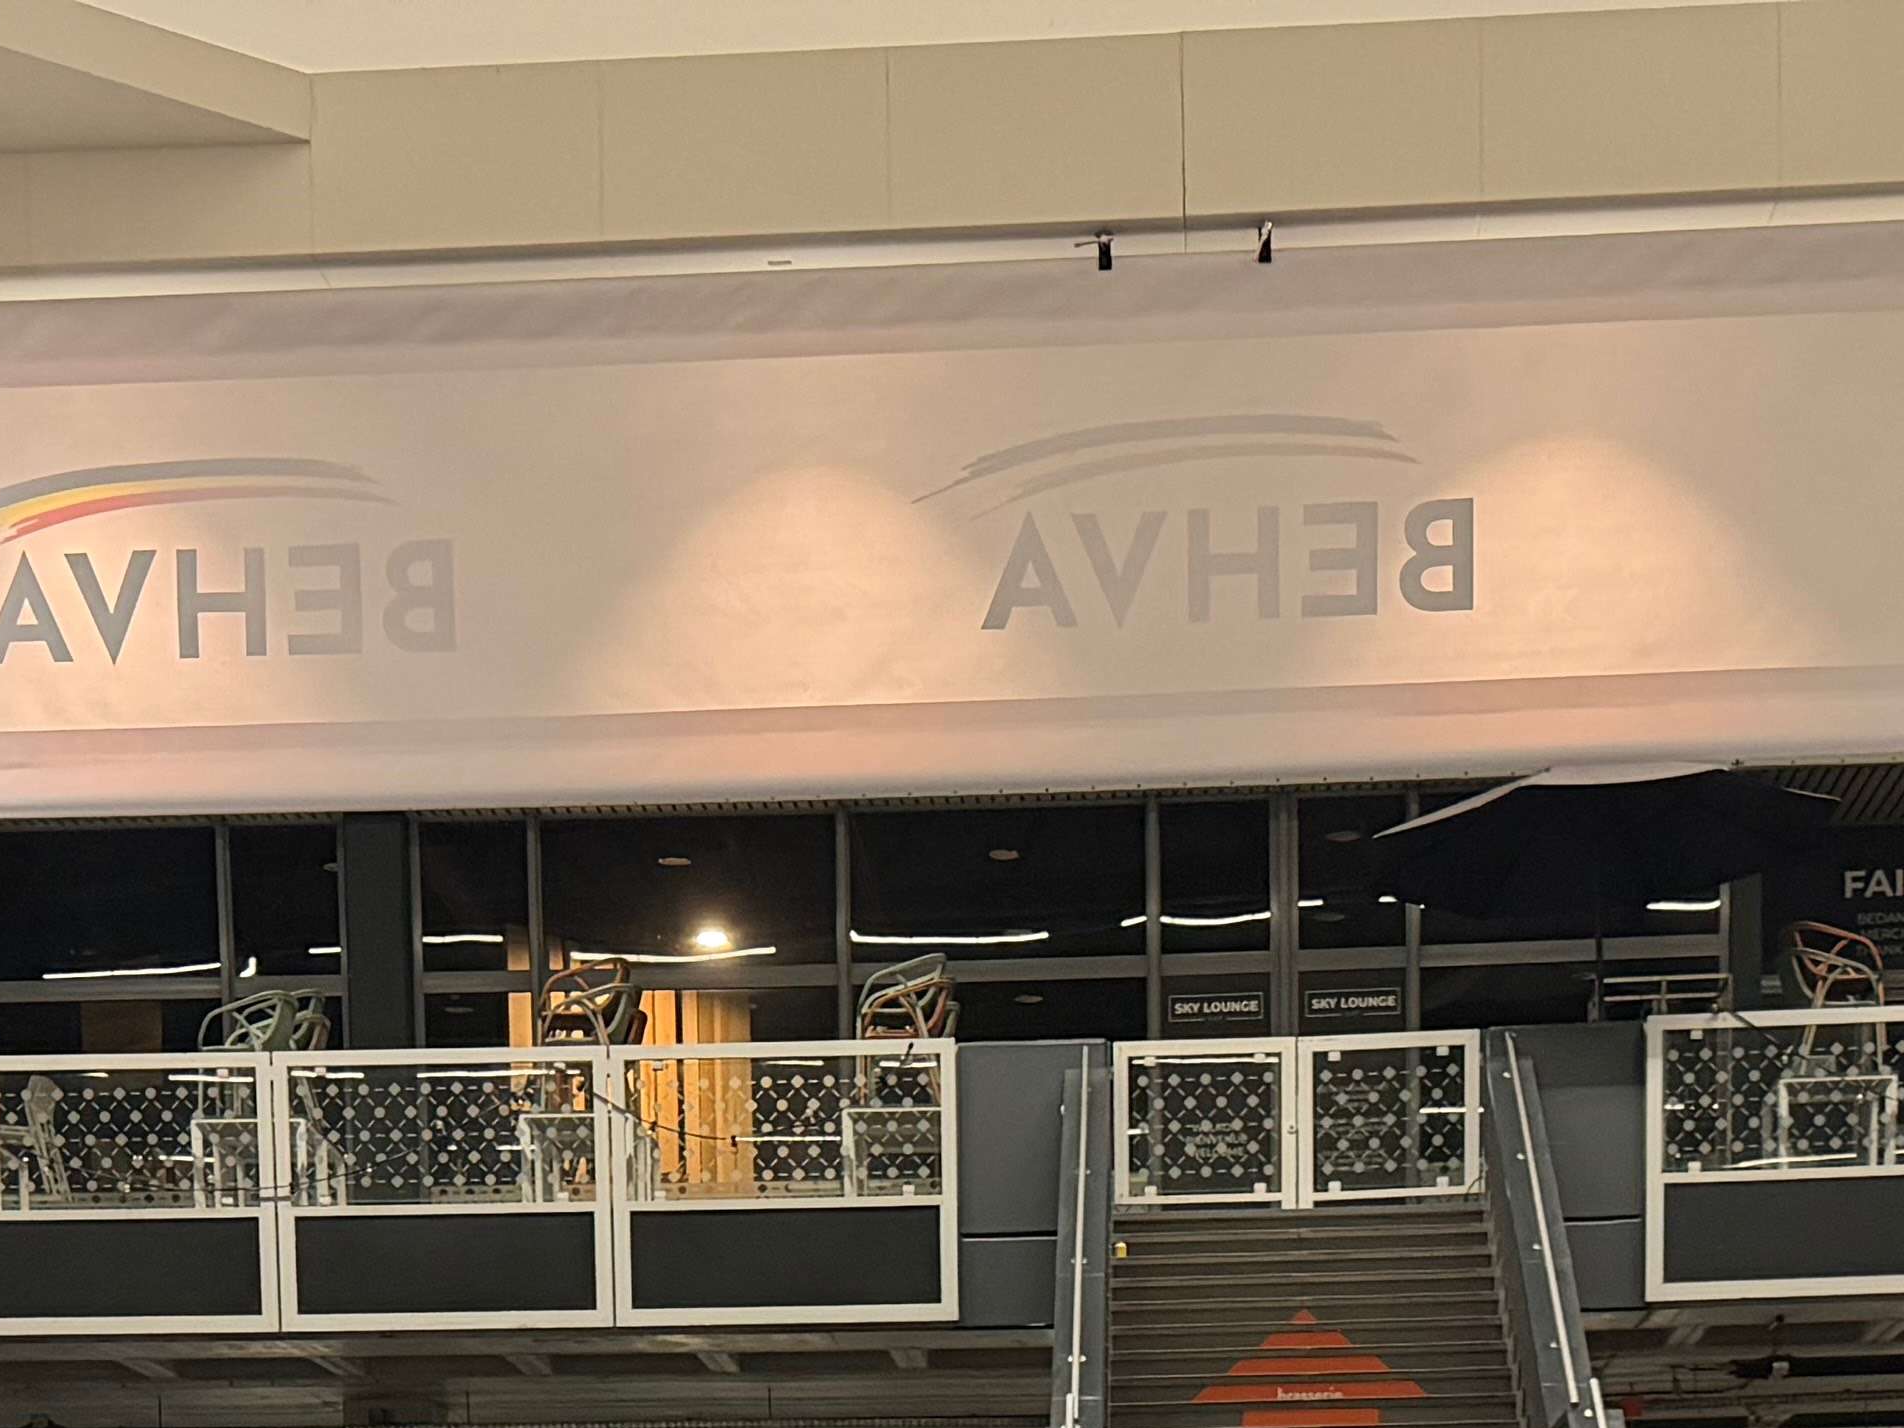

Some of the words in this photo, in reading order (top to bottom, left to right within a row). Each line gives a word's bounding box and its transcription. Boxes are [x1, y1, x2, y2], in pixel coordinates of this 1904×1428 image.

[1174, 1003, 1201, 1015] SKY
[1204, 1001, 1260, 1013] LOUNGE
[1311, 998, 1339, 1010] SKY
[1340, 996, 1397, 1008] LOUNGE
[1277, 1386, 1345, 1400] brasserie
